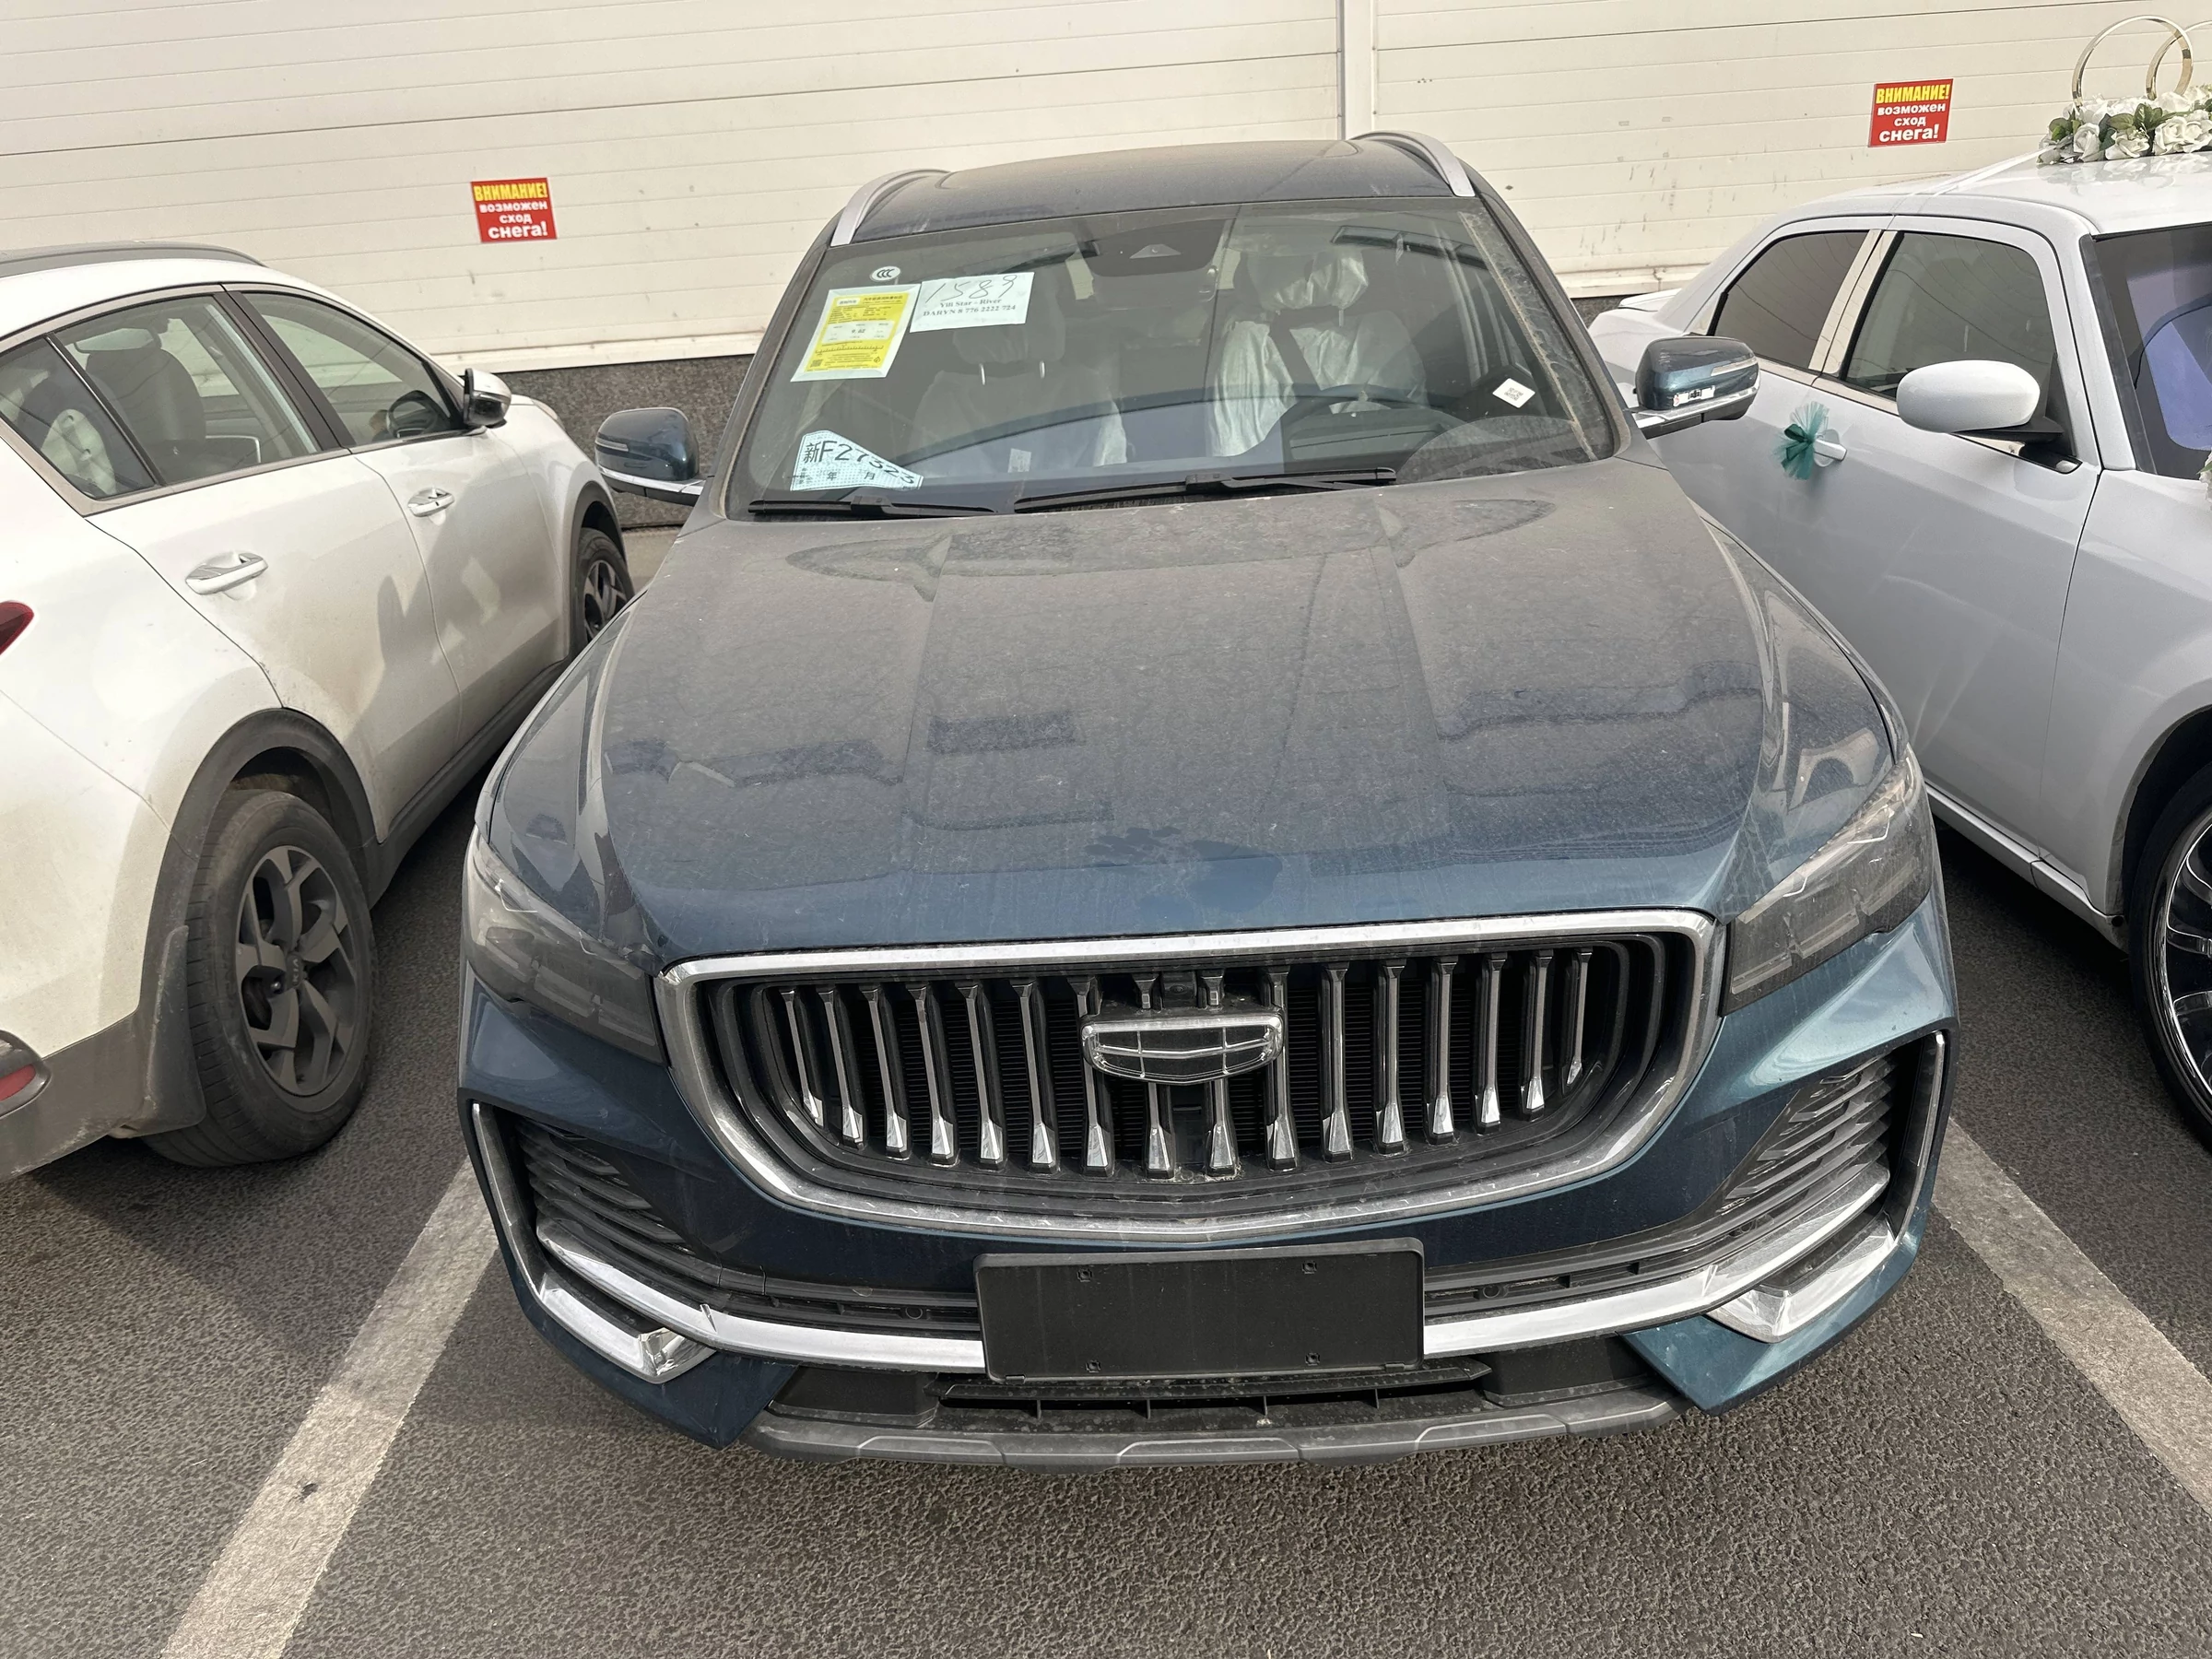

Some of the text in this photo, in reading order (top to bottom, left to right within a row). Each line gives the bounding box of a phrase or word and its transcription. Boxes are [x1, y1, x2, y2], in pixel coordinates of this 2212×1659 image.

[1876, 84, 1950, 104] ВНИМАНИЕ!
[1877, 103, 1946, 116] возможен
[1894, 116, 1926, 127] сход
[1878, 124, 1939, 142] снега!
[473, 182, 548, 202] ВНИМАНИЕ!
[479, 201, 547, 213] возможен
[499, 213, 533, 224] сход
[488, 220, 548, 239] снега!
[827, 471, 837, 481] 年
